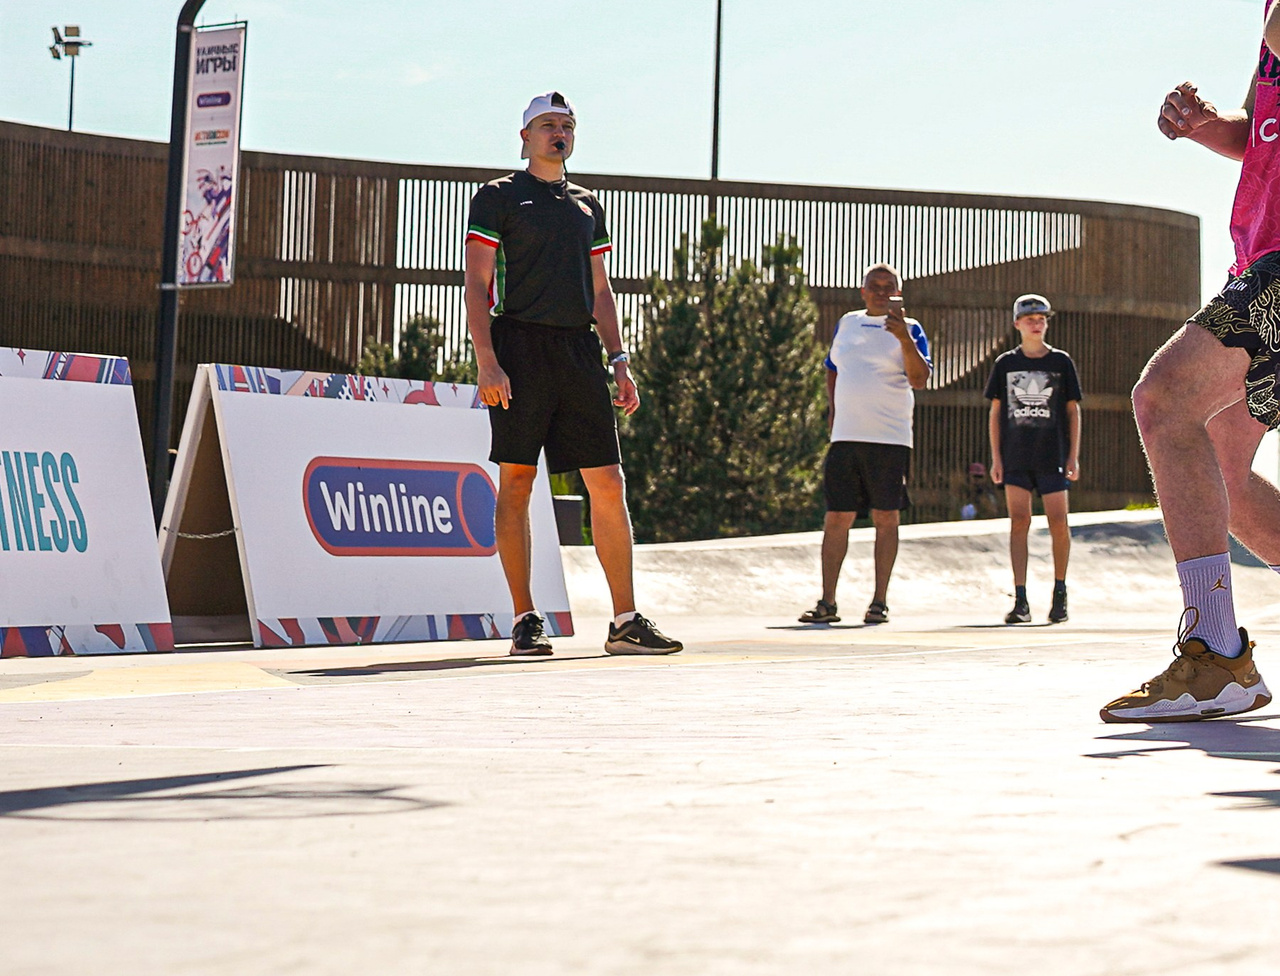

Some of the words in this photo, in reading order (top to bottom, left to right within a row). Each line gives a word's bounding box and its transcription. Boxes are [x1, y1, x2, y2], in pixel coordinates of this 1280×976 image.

[196, 55, 237, 74] ИГРЫ
[1013, 407, 1050, 418] adidas
[319, 481, 453, 534] Winline
